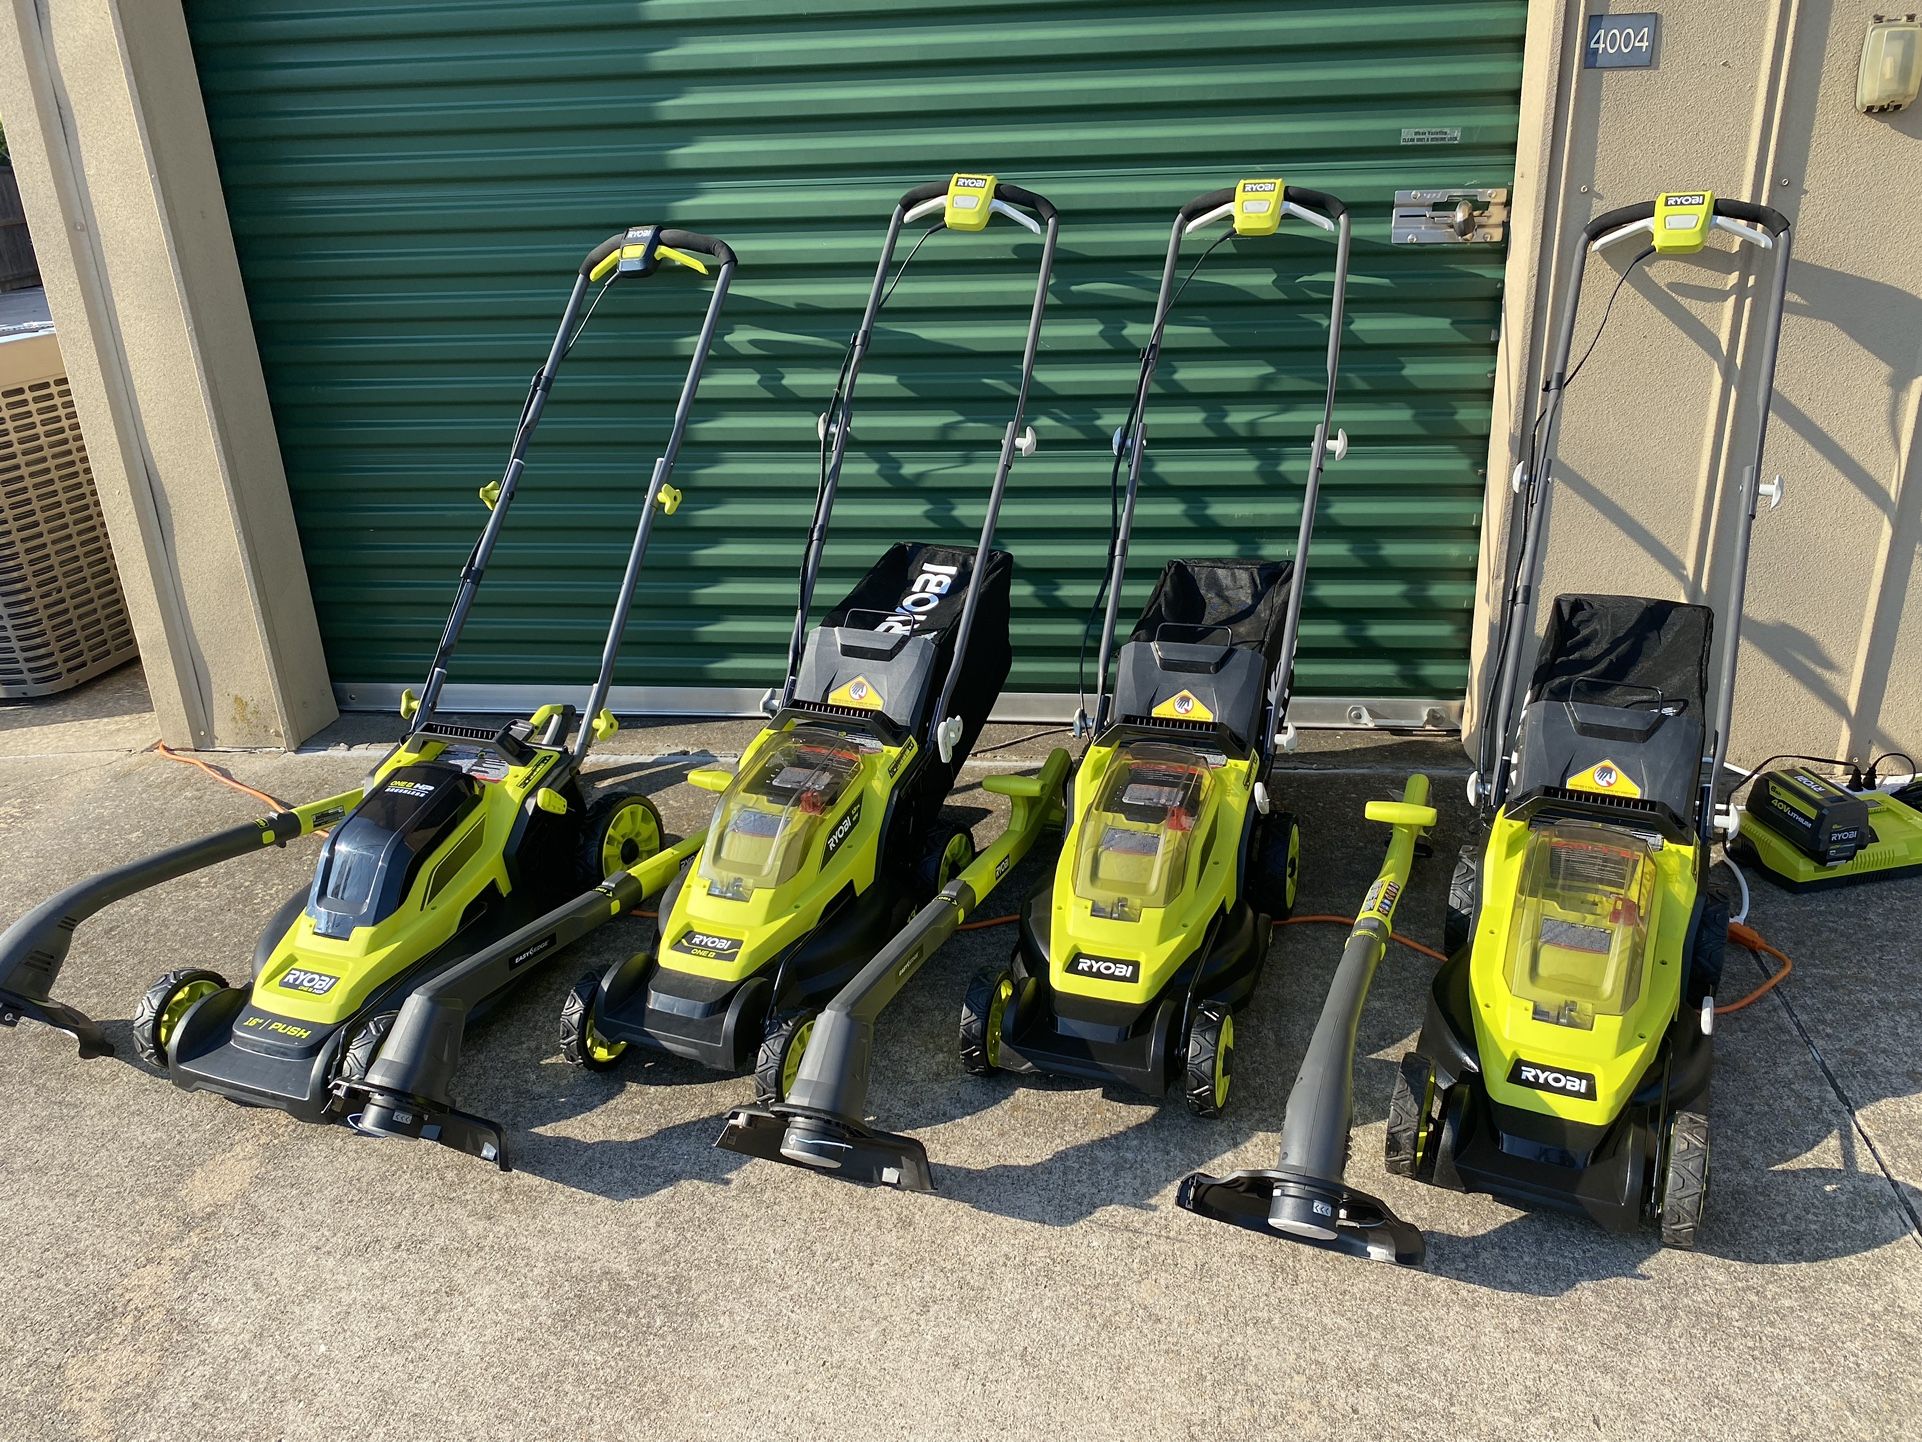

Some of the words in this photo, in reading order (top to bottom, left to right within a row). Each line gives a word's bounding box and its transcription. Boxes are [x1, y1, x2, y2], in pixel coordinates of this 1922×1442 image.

[1590, 27, 1648, 54] 4004
[957, 178, 986, 187] RYOBI
[1244, 183, 1275, 192] RYOBI
[1667, 195, 1703, 205] RYOBI
[627, 230, 652, 238] RYOBI
[873, 562, 958, 636] RYOBI
[827, 816, 852, 851] RYOBI
[1831, 830, 1858, 842] RYOBI
[691, 934, 732, 950] RYOBI
[1077, 958, 1134, 978] RYOBI
[283, 969, 336, 991] RYOBI
[267, 1022, 312, 1039] PUSH
[1521, 1066, 1587, 1094] RYOBI
